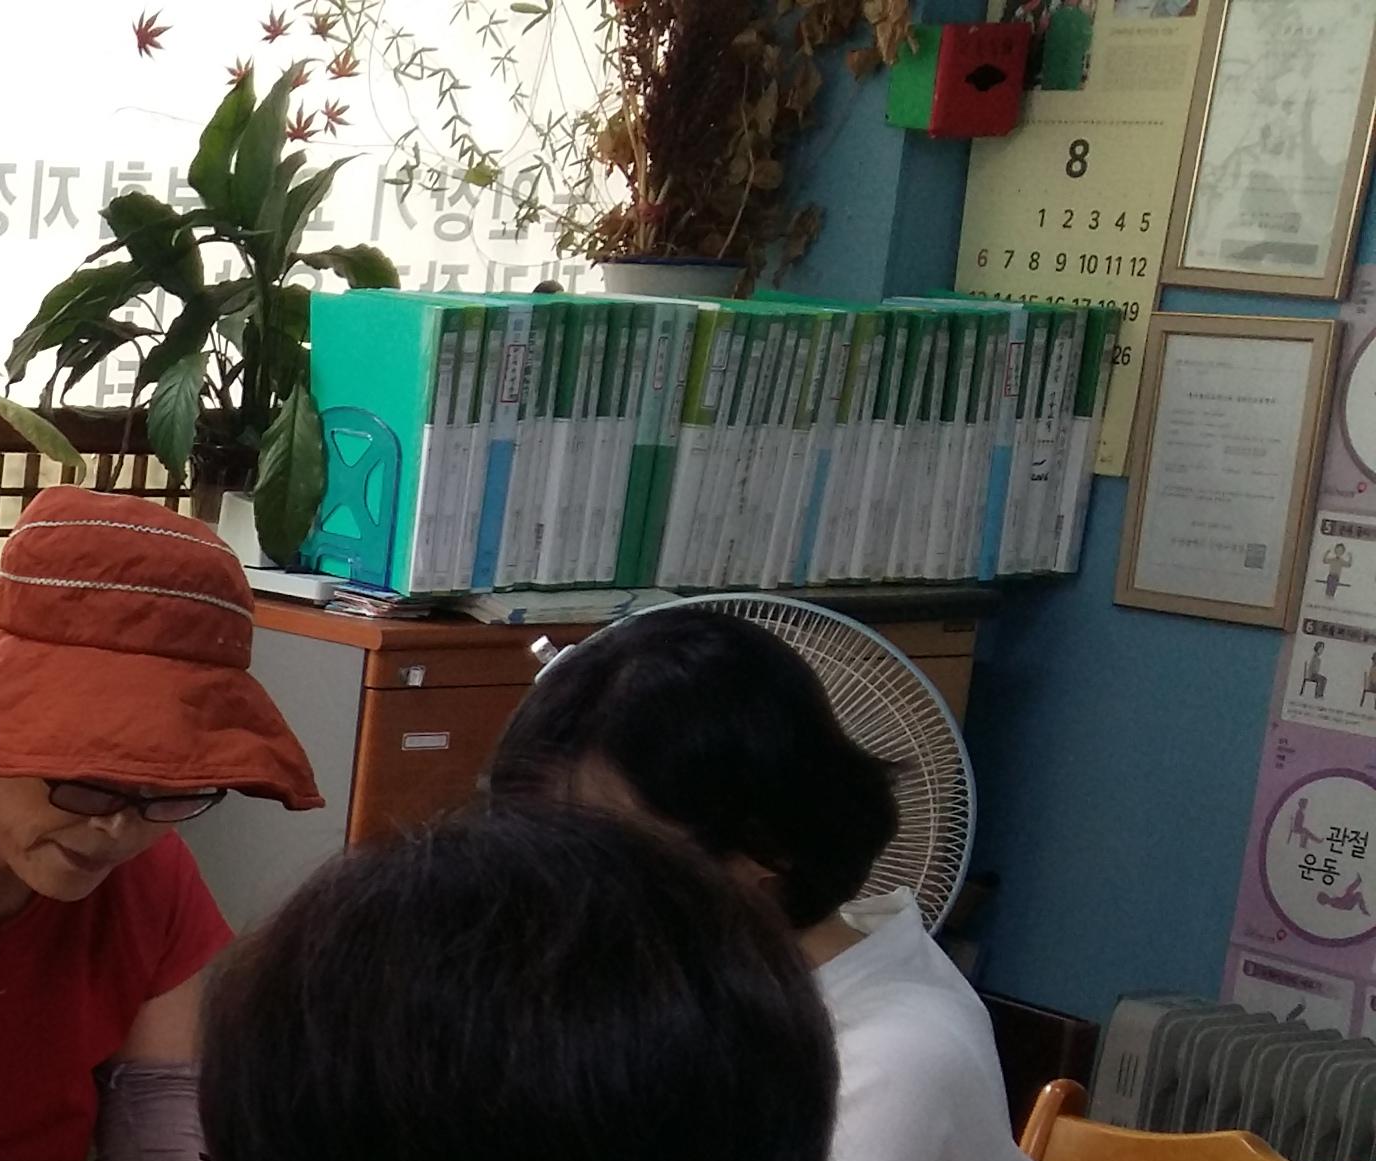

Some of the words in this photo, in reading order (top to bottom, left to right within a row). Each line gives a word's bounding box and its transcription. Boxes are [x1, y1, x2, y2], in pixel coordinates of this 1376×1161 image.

[1065, 138, 1090, 178] 8
[1037, 208, 1046, 228] 1
[1062, 209, 1075, 229] 2
[1087, 210, 1100, 230] 3
[1114, 211, 1127, 232] 4
[1139, 212, 1152, 232] 5
[976, 249, 989, 268] 6
[1003, 250, 1015, 269] 7
[1028, 251, 1040, 271] 8
[1055, 252, 1067, 272] 9
[1079, 254, 1099, 274] 10
[1105, 255, 1123, 275] 11
[1129, 257, 1148, 277] 12
[1121, 301, 1140, 322] 19
[1111, 345, 1131, 365] 26
[1326, 826, 1370, 860] 관절
[1298, 853, 1341, 886] 운동
